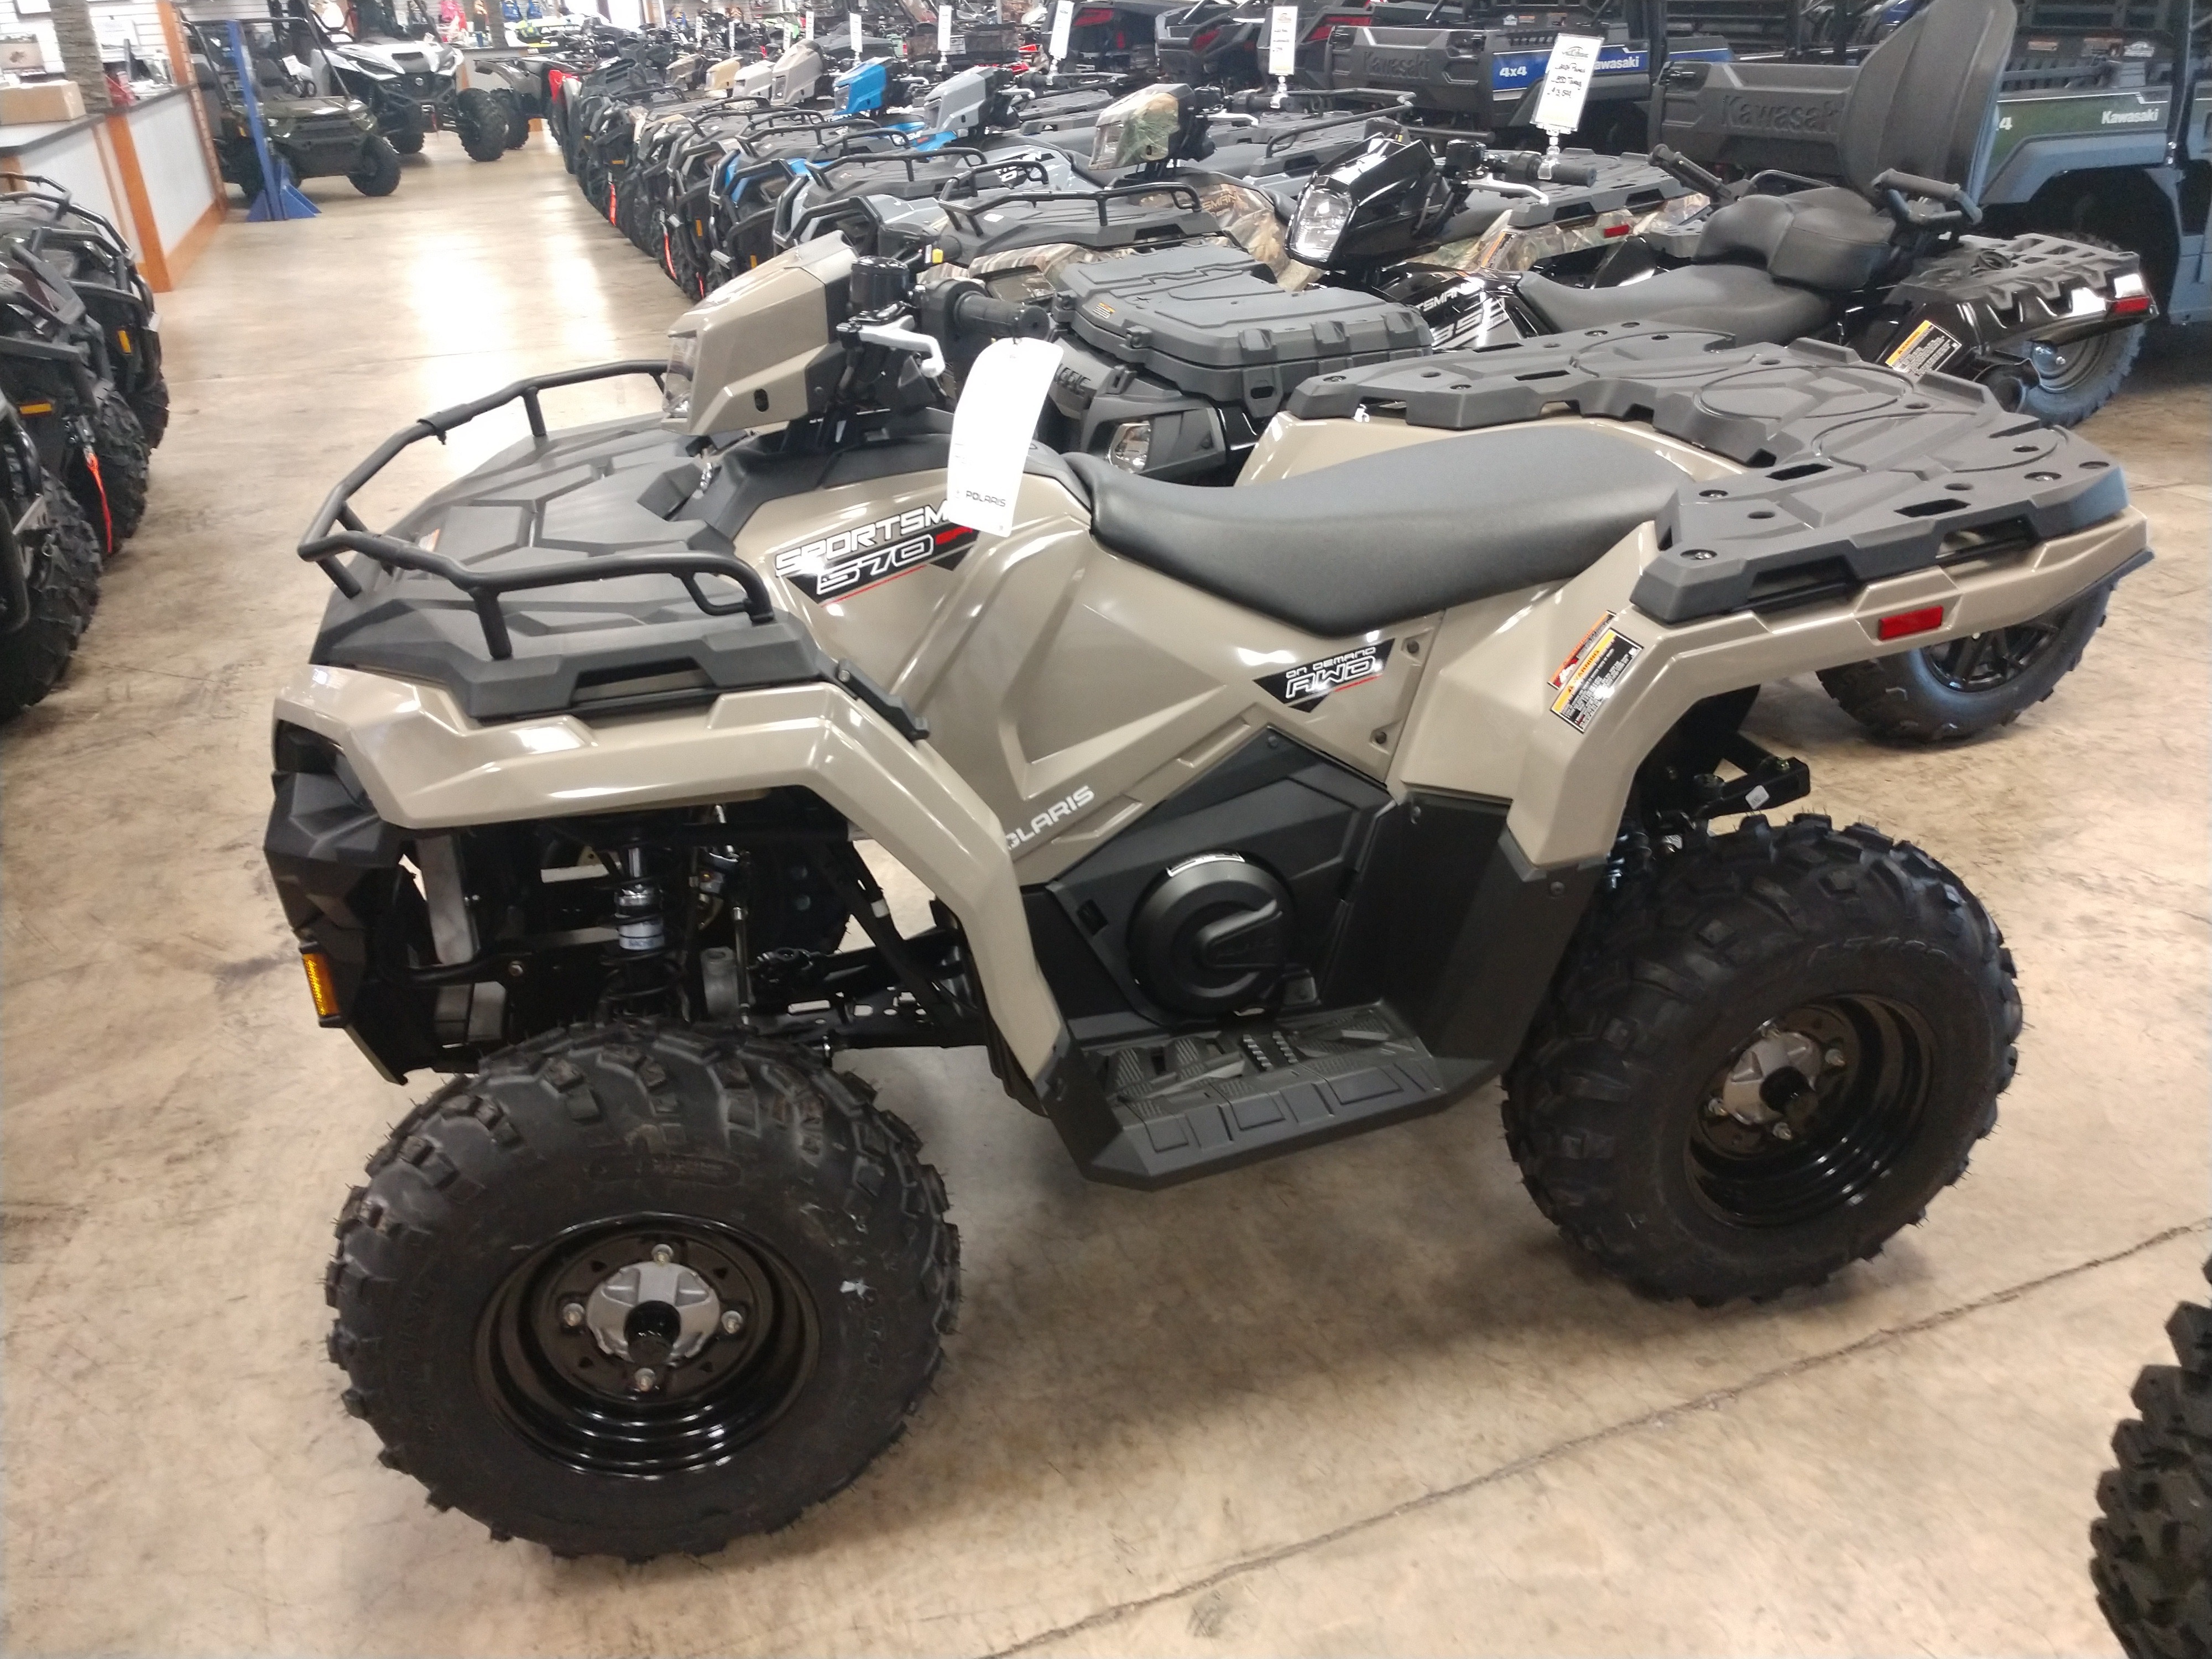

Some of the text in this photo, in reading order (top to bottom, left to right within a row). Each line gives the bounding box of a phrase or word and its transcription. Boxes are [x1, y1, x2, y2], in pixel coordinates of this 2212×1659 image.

[1499, 66, 1527, 77] 4x4
[1594, 56, 1639, 70] awasaki
[2101, 109, 2159, 124] Kawasaki
[966, 490, 1006, 508] POLARIS
[775, 499, 950, 578] SPORTSM
[817, 534, 935, 596] 570
[1285, 655, 1376, 699] AWD
[1005, 785, 1094, 850] OLARIS
